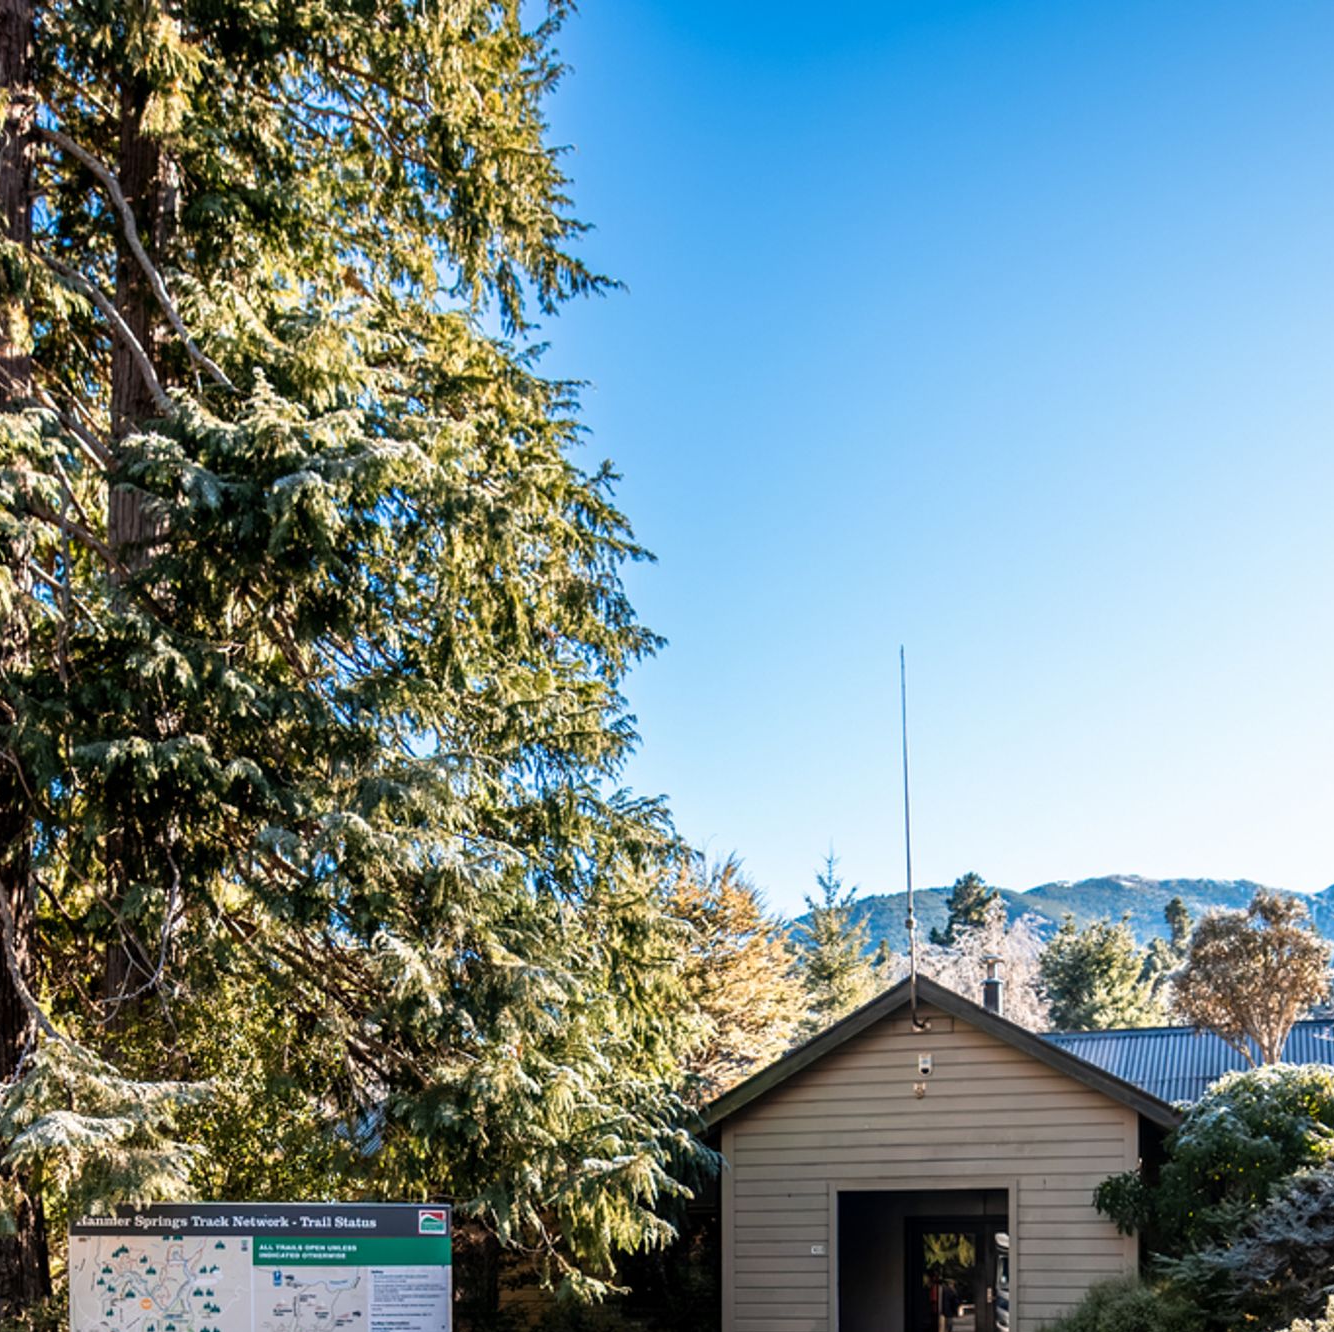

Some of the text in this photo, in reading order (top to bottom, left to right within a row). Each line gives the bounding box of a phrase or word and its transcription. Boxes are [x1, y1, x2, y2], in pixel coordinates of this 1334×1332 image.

[134, 1215, 188, 1230] Springs
[190, 1215, 230, 1228] Track
[232, 1215, 289, 1228] Network
[300, 1215, 332, 1228] Trail
[334, 1216, 377, 1229] Status
